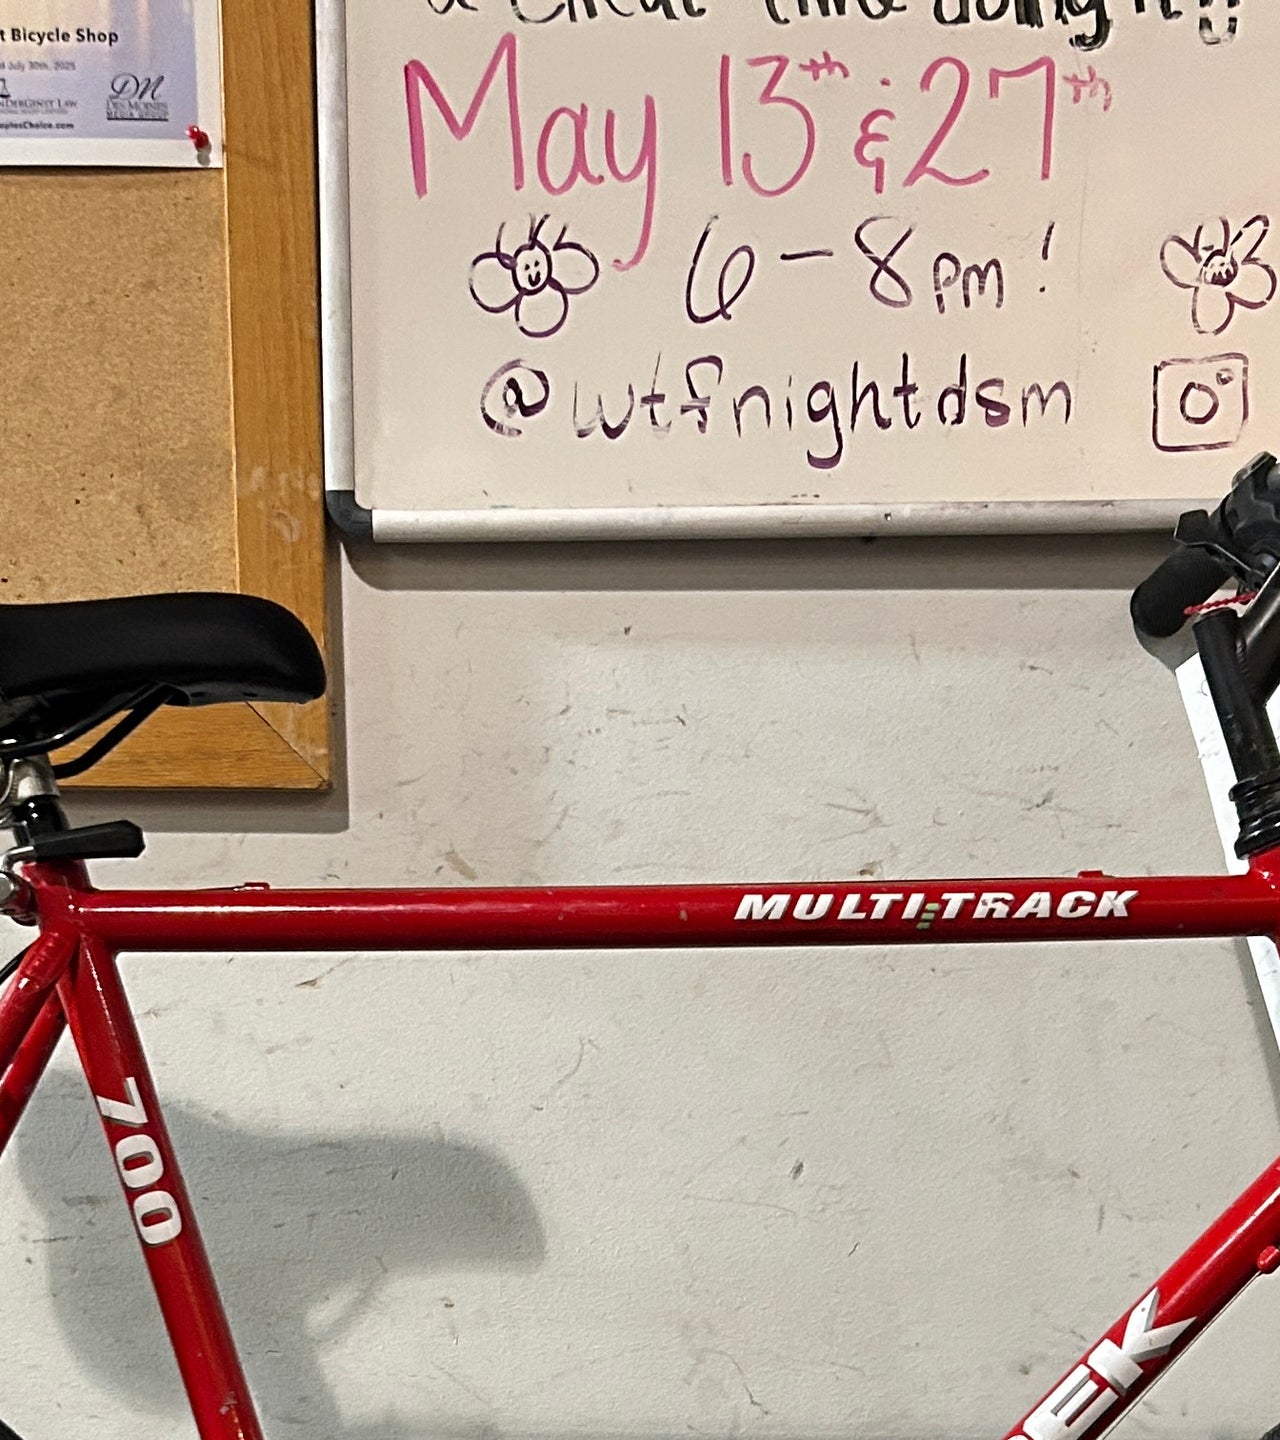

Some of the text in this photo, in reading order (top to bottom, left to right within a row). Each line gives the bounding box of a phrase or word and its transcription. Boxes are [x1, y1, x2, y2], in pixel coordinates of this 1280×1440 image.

[11, 28, 70, 45] Bicycle
[76, 28, 119, 46] Shop
[404, 32, 657, 272] May
[720, 51, 850, 197] 13th
[903, 55, 1112, 187] 27th
[685, 215, 755, 324] 6
[96, 1077, 182, 1246] 700
